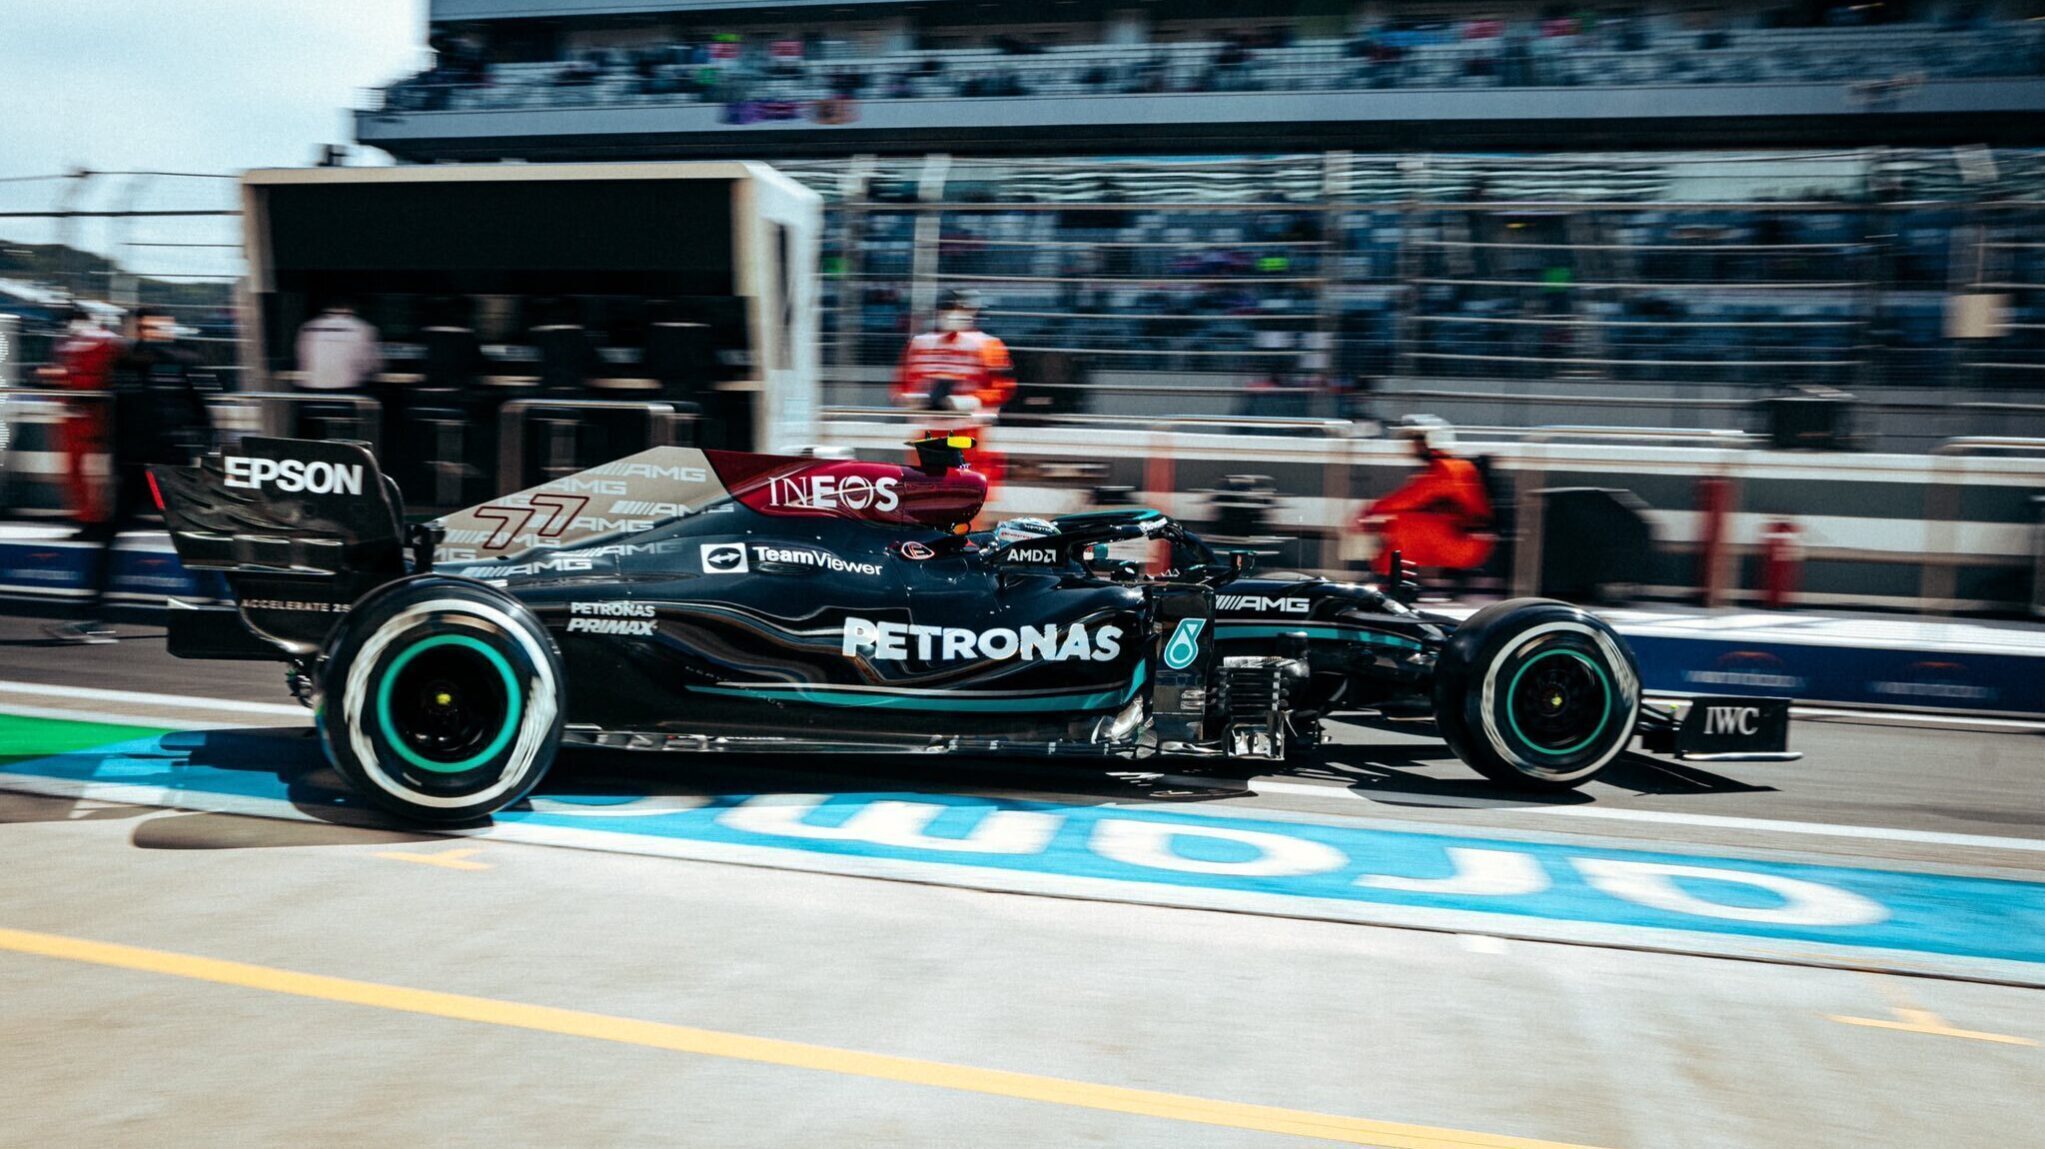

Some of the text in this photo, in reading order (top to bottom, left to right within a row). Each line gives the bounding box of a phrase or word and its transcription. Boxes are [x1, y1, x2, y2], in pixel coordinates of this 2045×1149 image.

[224, 456, 363, 495] EPSON
[624, 463, 706, 482] AMG
[768, 475, 899, 511] INEOS
[473, 493, 590, 550] 77
[569, 514, 654, 533] AMG
[752, 546, 883, 575] TeamViewer
[1007, 549, 1044, 563] AMD
[504, 558, 592, 576] AMG
[241, 599, 330, 612] ACCELERATE
[570, 601, 656, 617] PETRONAS
[1235, 595, 1310, 612] AMG
[566, 618, 658, 636] PRIMAX
[842, 616, 1124, 661] PETRONAS
[1703, 706, 1759, 735] IWC
